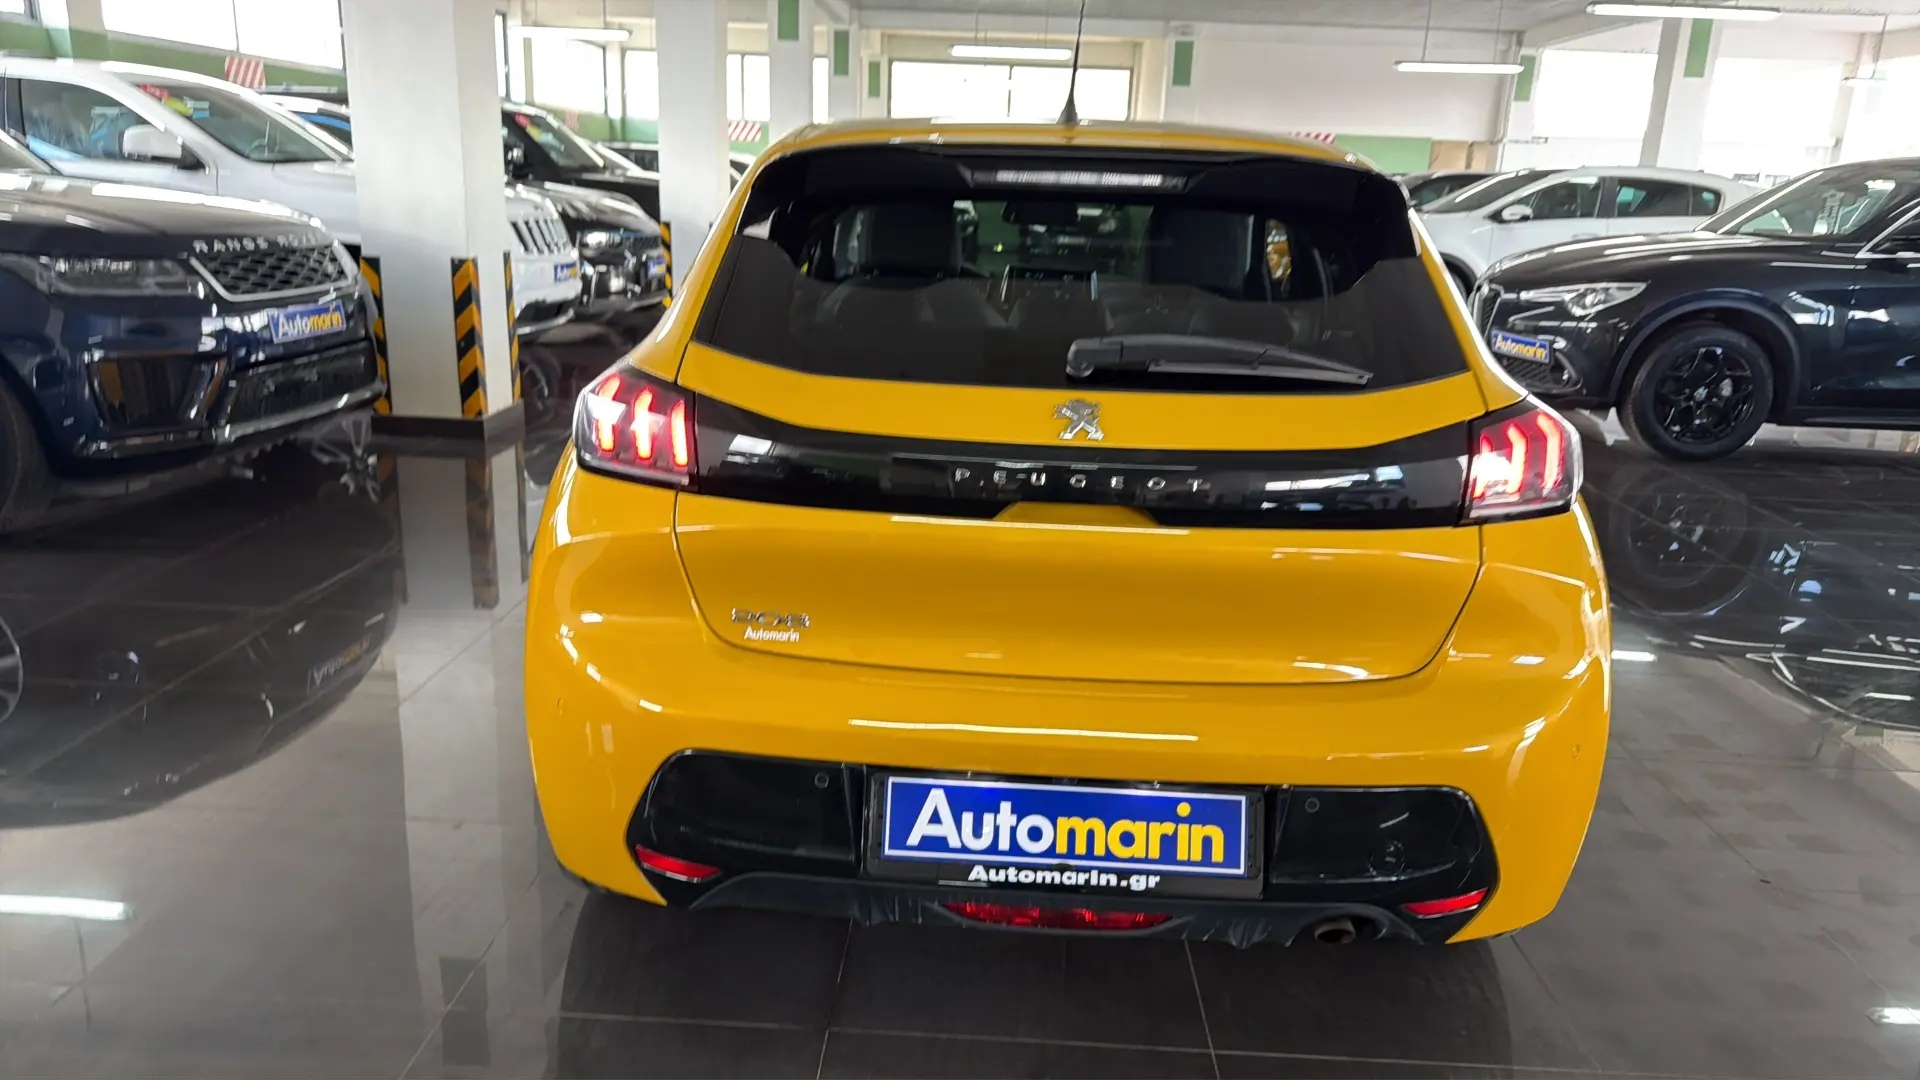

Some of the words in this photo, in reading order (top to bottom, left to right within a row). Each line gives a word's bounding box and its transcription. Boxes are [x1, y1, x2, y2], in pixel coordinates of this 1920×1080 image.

[278, 303, 342, 339] Automarin
[955, 468, 1204, 492] PEUGEOT
[744, 626, 800, 643] Automarin
[905, 787, 1225, 863] Automarin
[968, 865, 1161, 891] Automarin.gr
